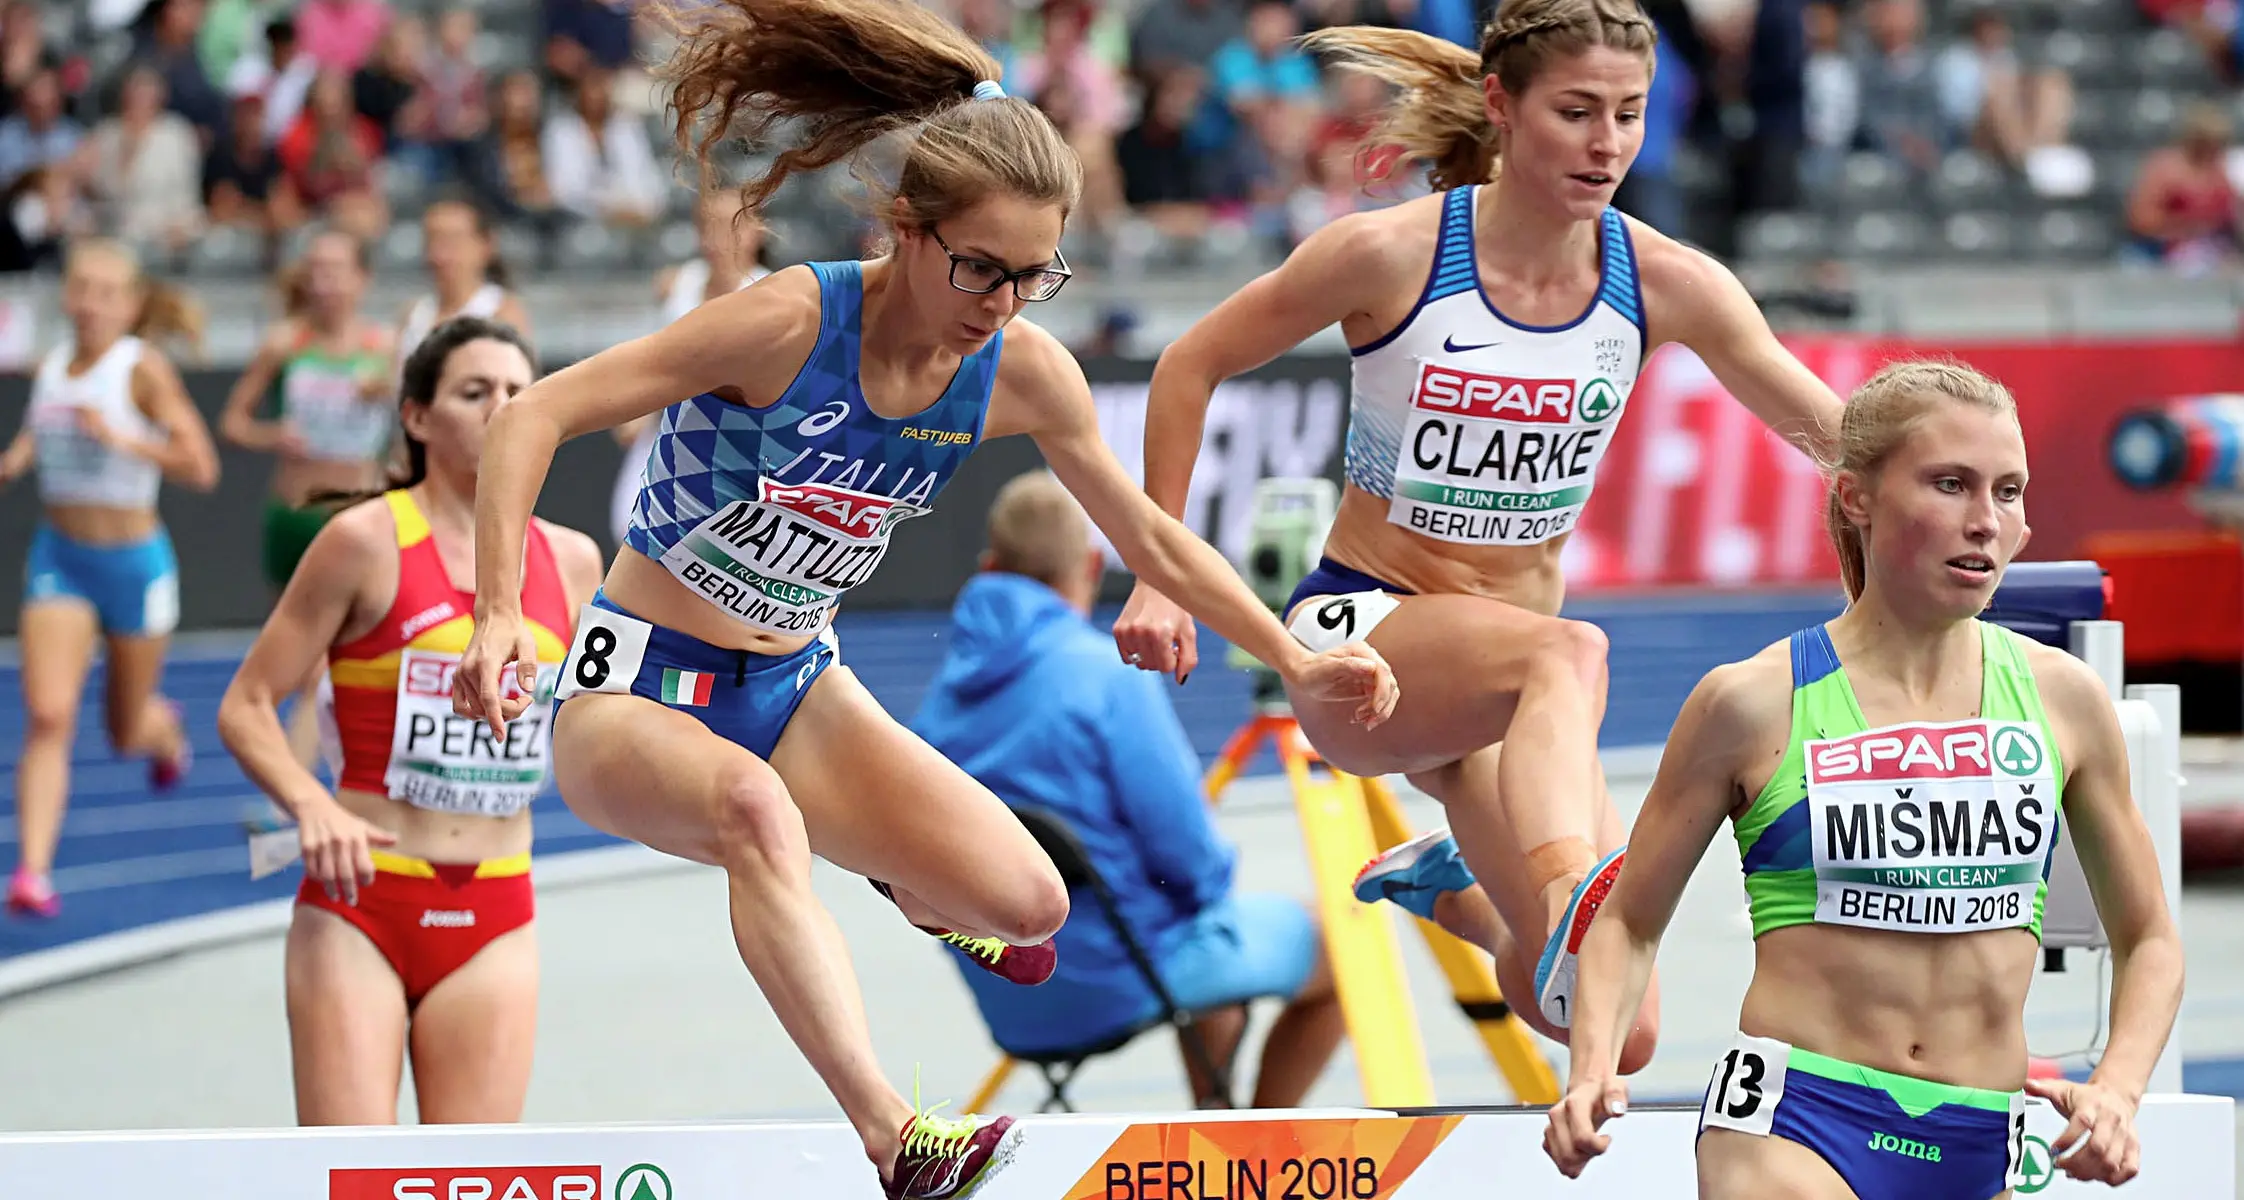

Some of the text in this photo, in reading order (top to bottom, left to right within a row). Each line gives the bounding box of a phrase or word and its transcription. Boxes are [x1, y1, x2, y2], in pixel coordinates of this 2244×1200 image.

[1422, 372, 1572, 417] SPAR
[900, 426, 972, 447] FASTWEB
[1413, 419, 1602, 484] CLARKE
[774, 447, 938, 507] ITALIA
[1442, 487, 1450, 503] I
[1453, 489, 1495, 508] RUN
[1410, 506, 1511, 540] BERLIN
[682, 561, 825, 631] BERLIN 2018
[725, 561, 736, 570] I
[734, 568, 770, 593] RUN
[575, 626, 617, 689] 8
[1816, 731, 1988, 778] SPAR
[1825, 784, 2043, 861] MIŠMAŠ
[1874, 870, 1880, 884] I
[1886, 869, 1931, 886] RUN
[1839, 888, 2020, 925] BERLIN 2018
[1714, 1048, 1766, 1119] 13
[393, 1174, 597, 1200] SPAR
[1105, 1157, 1379, 1200] BERLIN 2018
